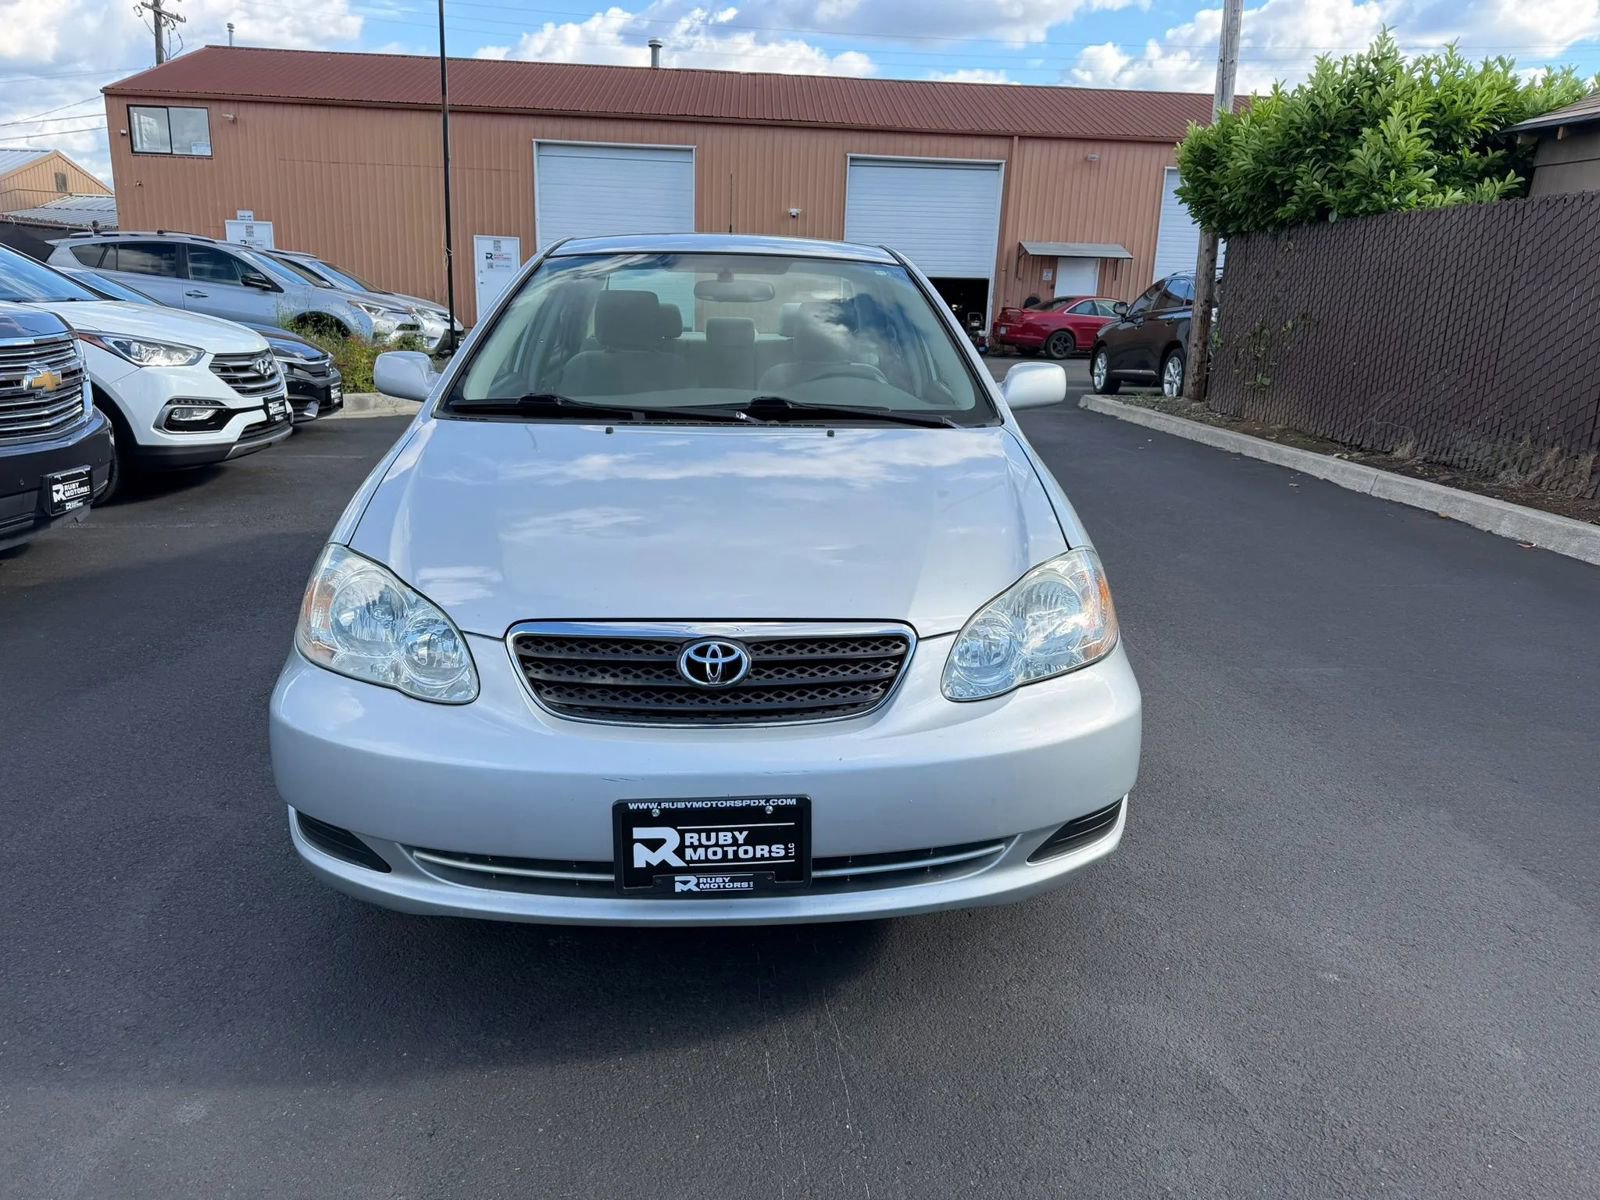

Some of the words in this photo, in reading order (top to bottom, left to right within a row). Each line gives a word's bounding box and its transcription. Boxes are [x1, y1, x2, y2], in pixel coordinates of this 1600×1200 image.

[628, 798, 797, 810] WWW.RUBYMOTORSPDX.COM
[684, 830, 749, 846] RUBY
[685, 844, 785, 860] MOTORS
